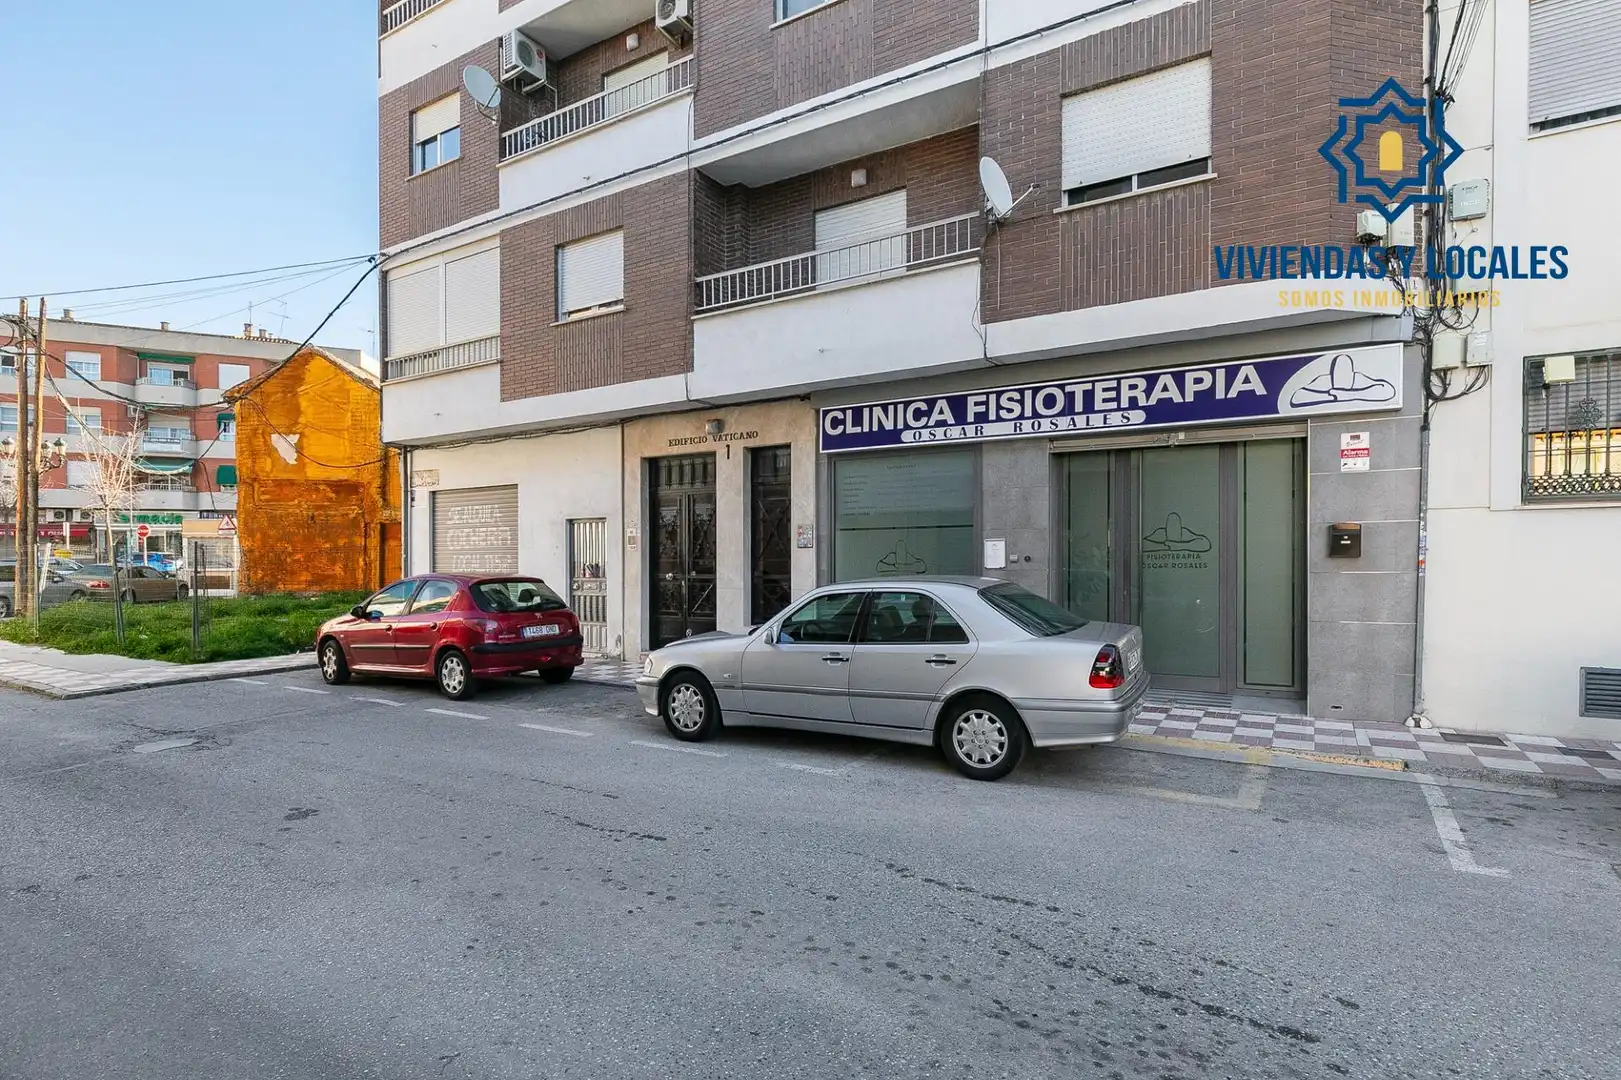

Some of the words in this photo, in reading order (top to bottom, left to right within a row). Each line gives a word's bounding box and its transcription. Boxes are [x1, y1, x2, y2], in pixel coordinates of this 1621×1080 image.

[824, 400, 955, 436] CLINICA
[965, 364, 1268, 423] FISIOTERAPIA
[668, 435, 708, 447] EDIFICIO
[712, 430, 759, 442] VATICANO
[912, 425, 985, 442] OSCAR
[1012, 411, 1133, 433] ROSALES
[725, 444, 731, 459] 1
